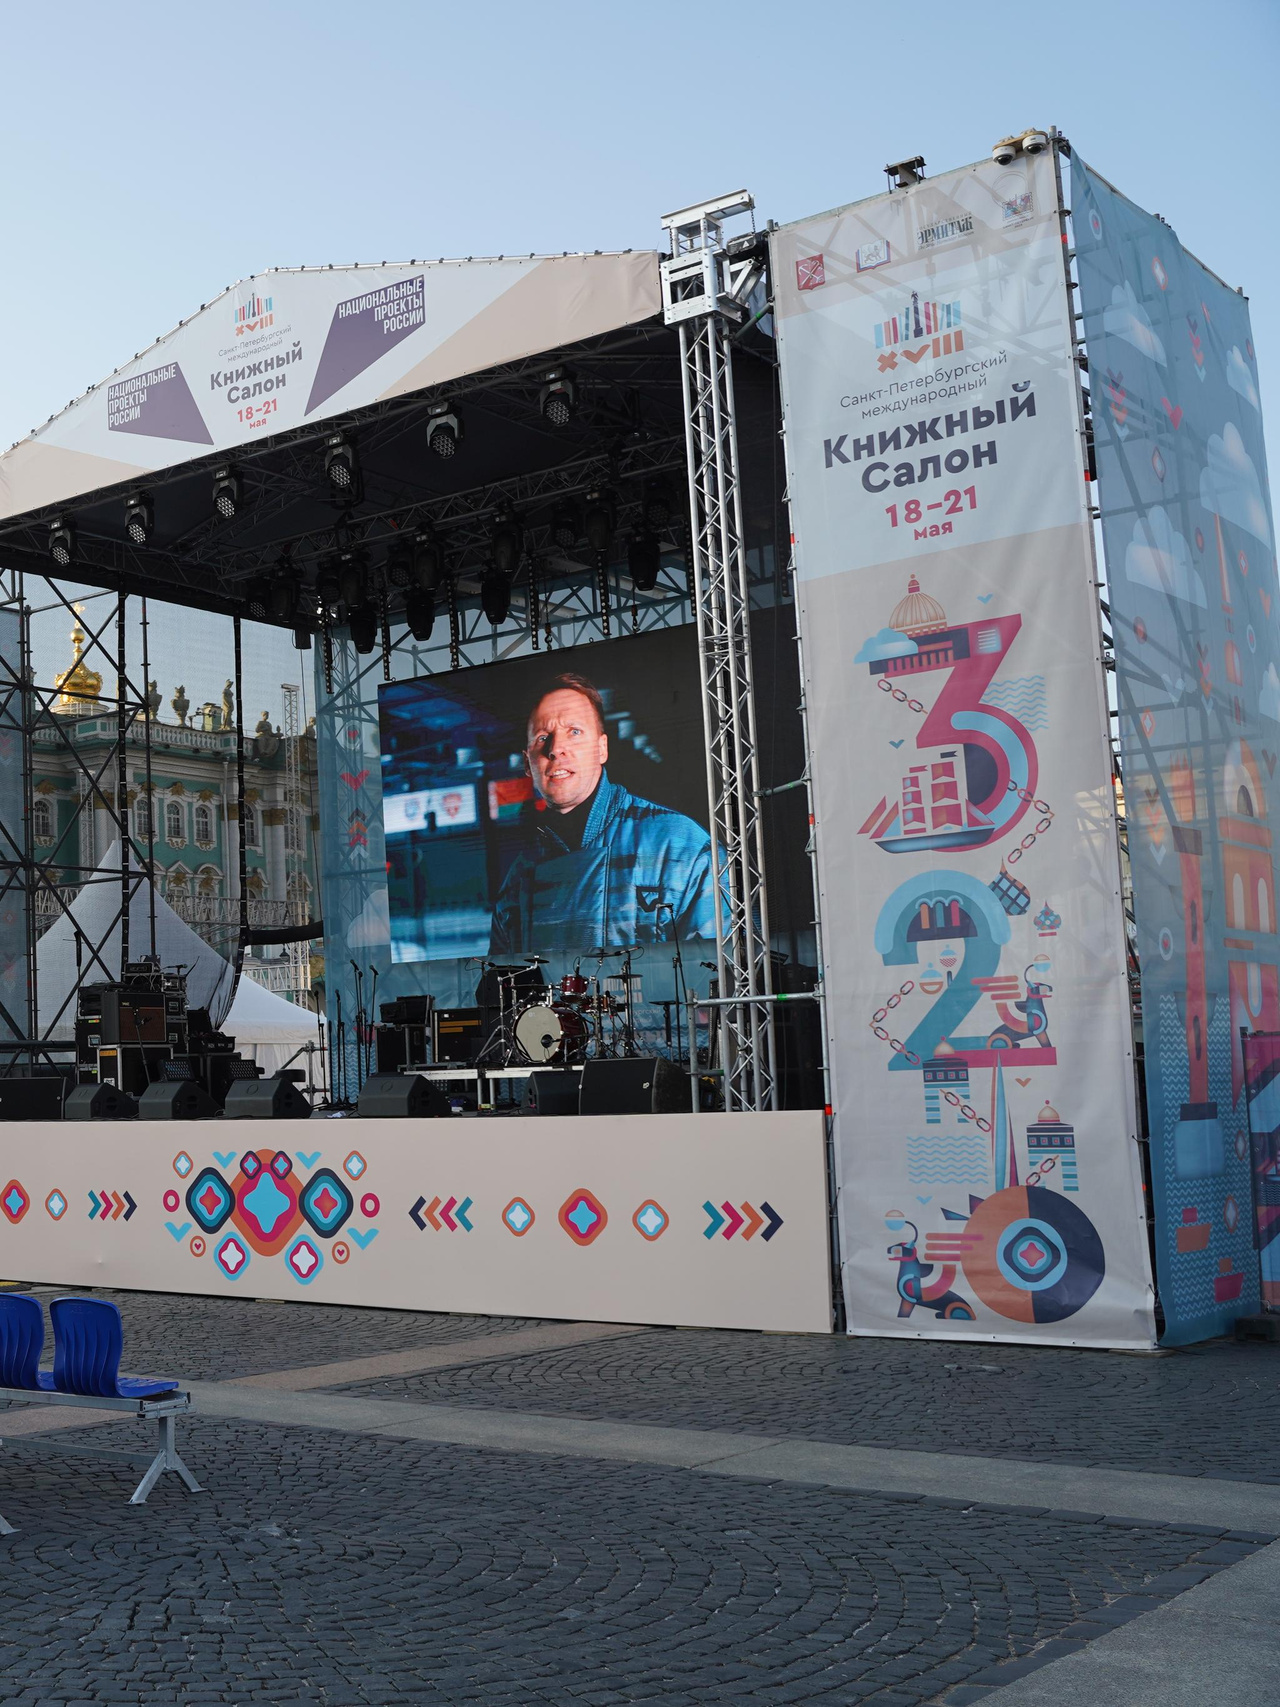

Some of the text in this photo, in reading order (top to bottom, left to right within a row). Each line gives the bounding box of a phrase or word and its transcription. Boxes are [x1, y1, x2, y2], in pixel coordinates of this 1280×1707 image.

[338, 277, 424, 319] НАЦИОНАЛЬНЫЕ
[373, 292, 424, 322] ПРОЕКТЫ
[383, 311, 424, 335] РОССИИ
[218, 324, 293, 358] Санкт-Петербургский
[227, 337, 283, 364] международный
[108, 364, 177, 400] НАЦИОНАЛЬНЫЕ
[210, 341, 303, 391] Книжный
[840, 350, 1008, 409] Санкт-Петербургский
[108, 389, 148, 414] ПРОЕКТЫ
[226, 373, 287, 405] Салон
[862, 373, 988, 419] международный
[109, 407, 141, 428] РОССИИ
[249, 417, 267, 430] мая
[824, 380, 1037, 468] Книжный
[861, 440, 998, 494] Салон
[913, 520, 954, 541] мая
